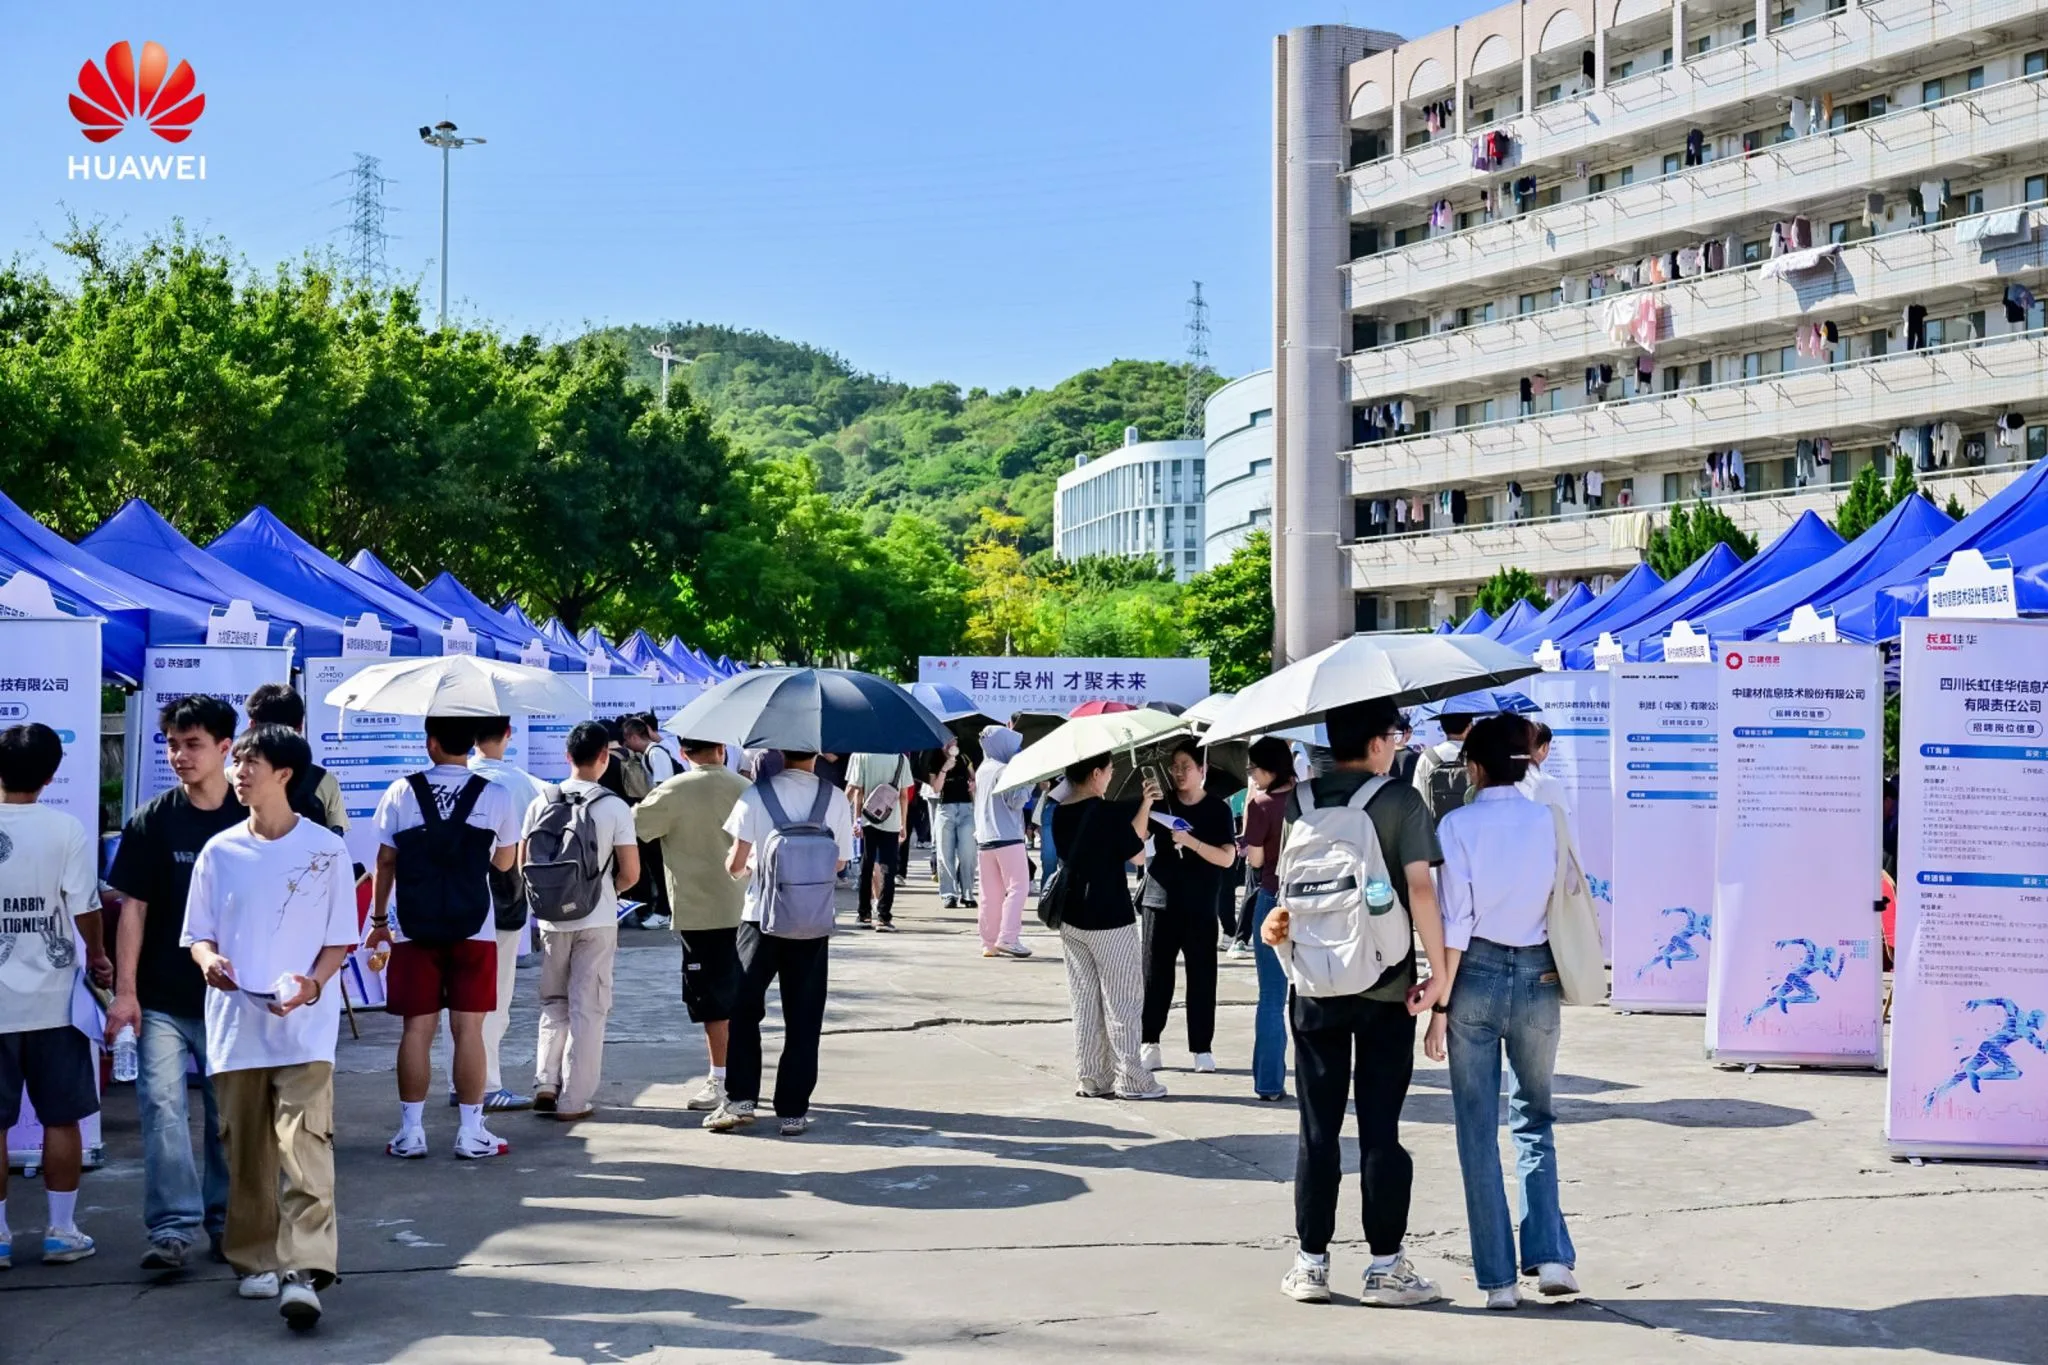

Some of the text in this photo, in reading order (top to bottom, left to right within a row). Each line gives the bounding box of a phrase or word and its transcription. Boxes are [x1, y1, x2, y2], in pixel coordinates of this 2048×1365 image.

[1932, 584, 2009, 608] 中建材信息技术股份有限公司
[1926, 633, 1978, 644] 长虹佳华
[970, 670, 1147, 690] 智汇泉州 才聚未来
[1732, 688, 1865, 700] 中建材信息技术股份有限公司
[1965, 698, 2041, 713] 有限责任公司
[1776, 710, 1824, 718] 招聘岗位信息
[1973, 722, 2035, 733] 招聘岗位信息
